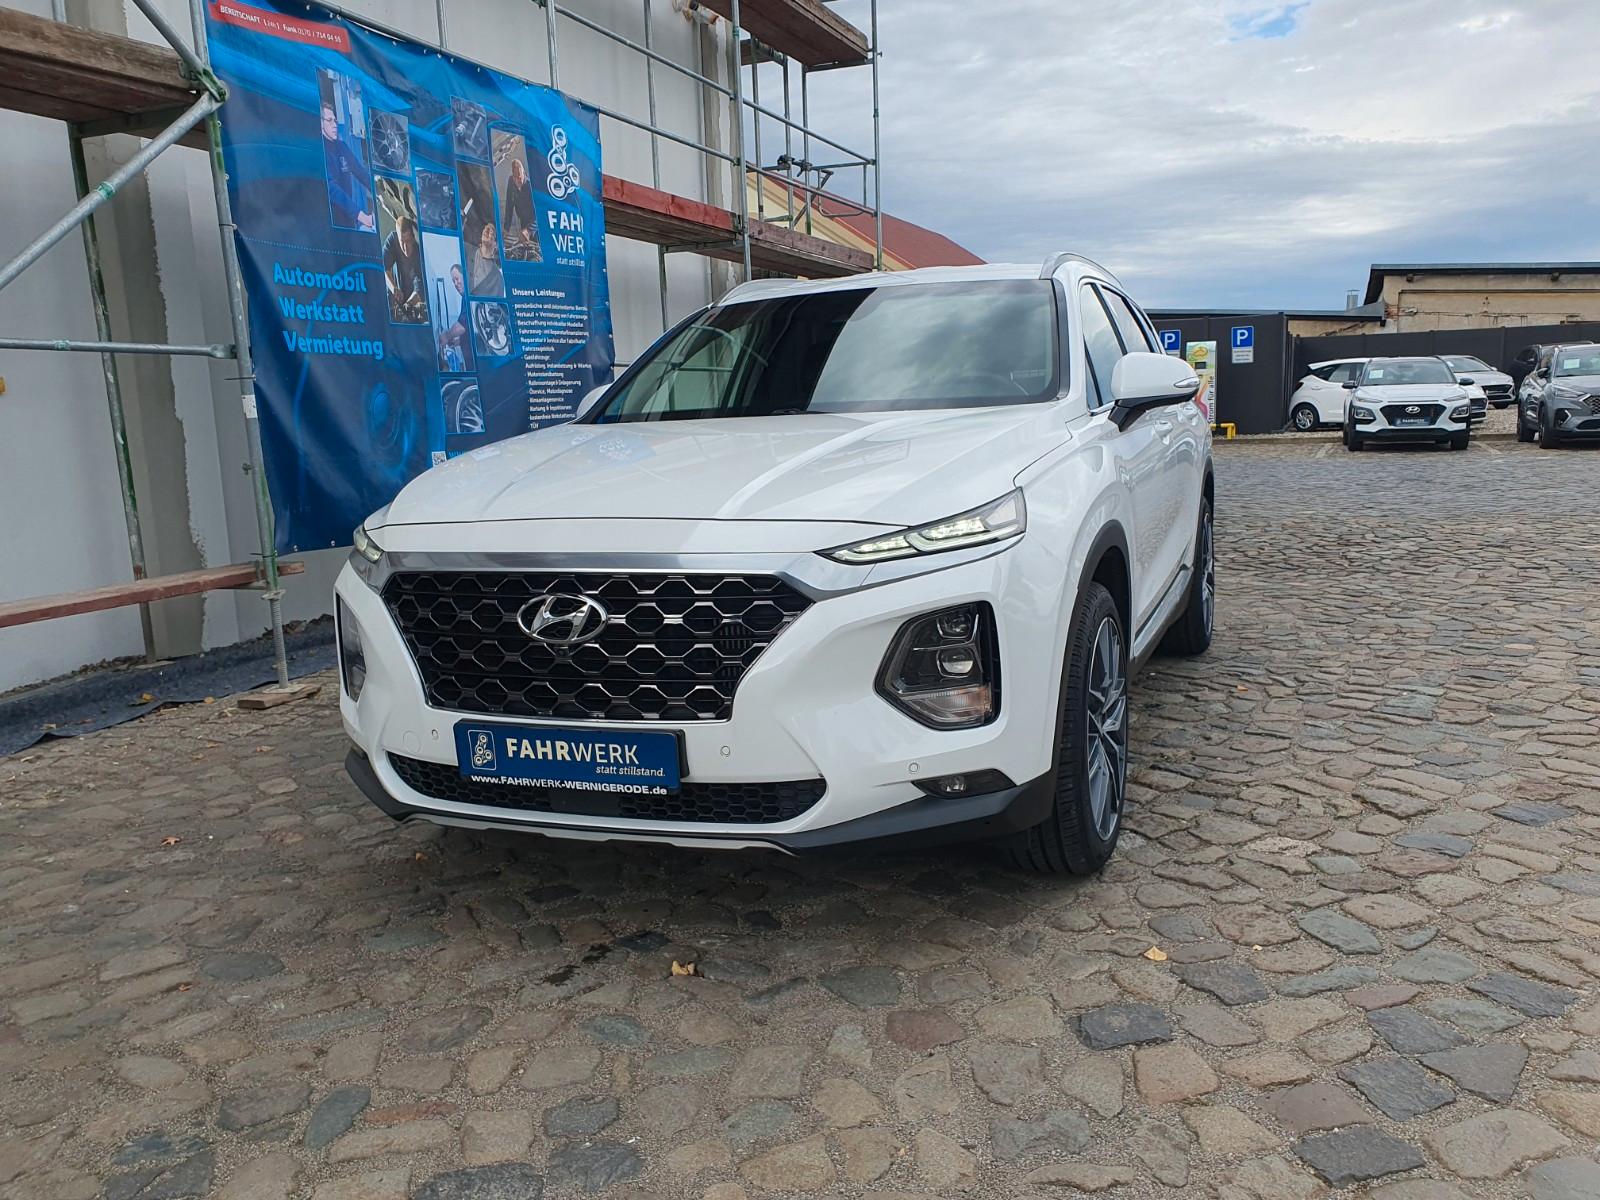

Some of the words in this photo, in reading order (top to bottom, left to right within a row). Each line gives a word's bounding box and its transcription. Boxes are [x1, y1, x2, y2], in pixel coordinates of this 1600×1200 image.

[274, 262, 367, 292] Automobil
[512, 288, 534, 296] Unsere
[279, 296, 365, 323] Werkstatt
[282, 330, 384, 360] Vermietung
[1236, 330, 1248, 346] P
[506, 738, 640, 765] FAHRWERK
[596, 764, 617, 775] statt
[618, 766, 666, 778] stillstand.
[471, 774, 668, 796] www.FAHRWERK-WERNIGERODE.de
